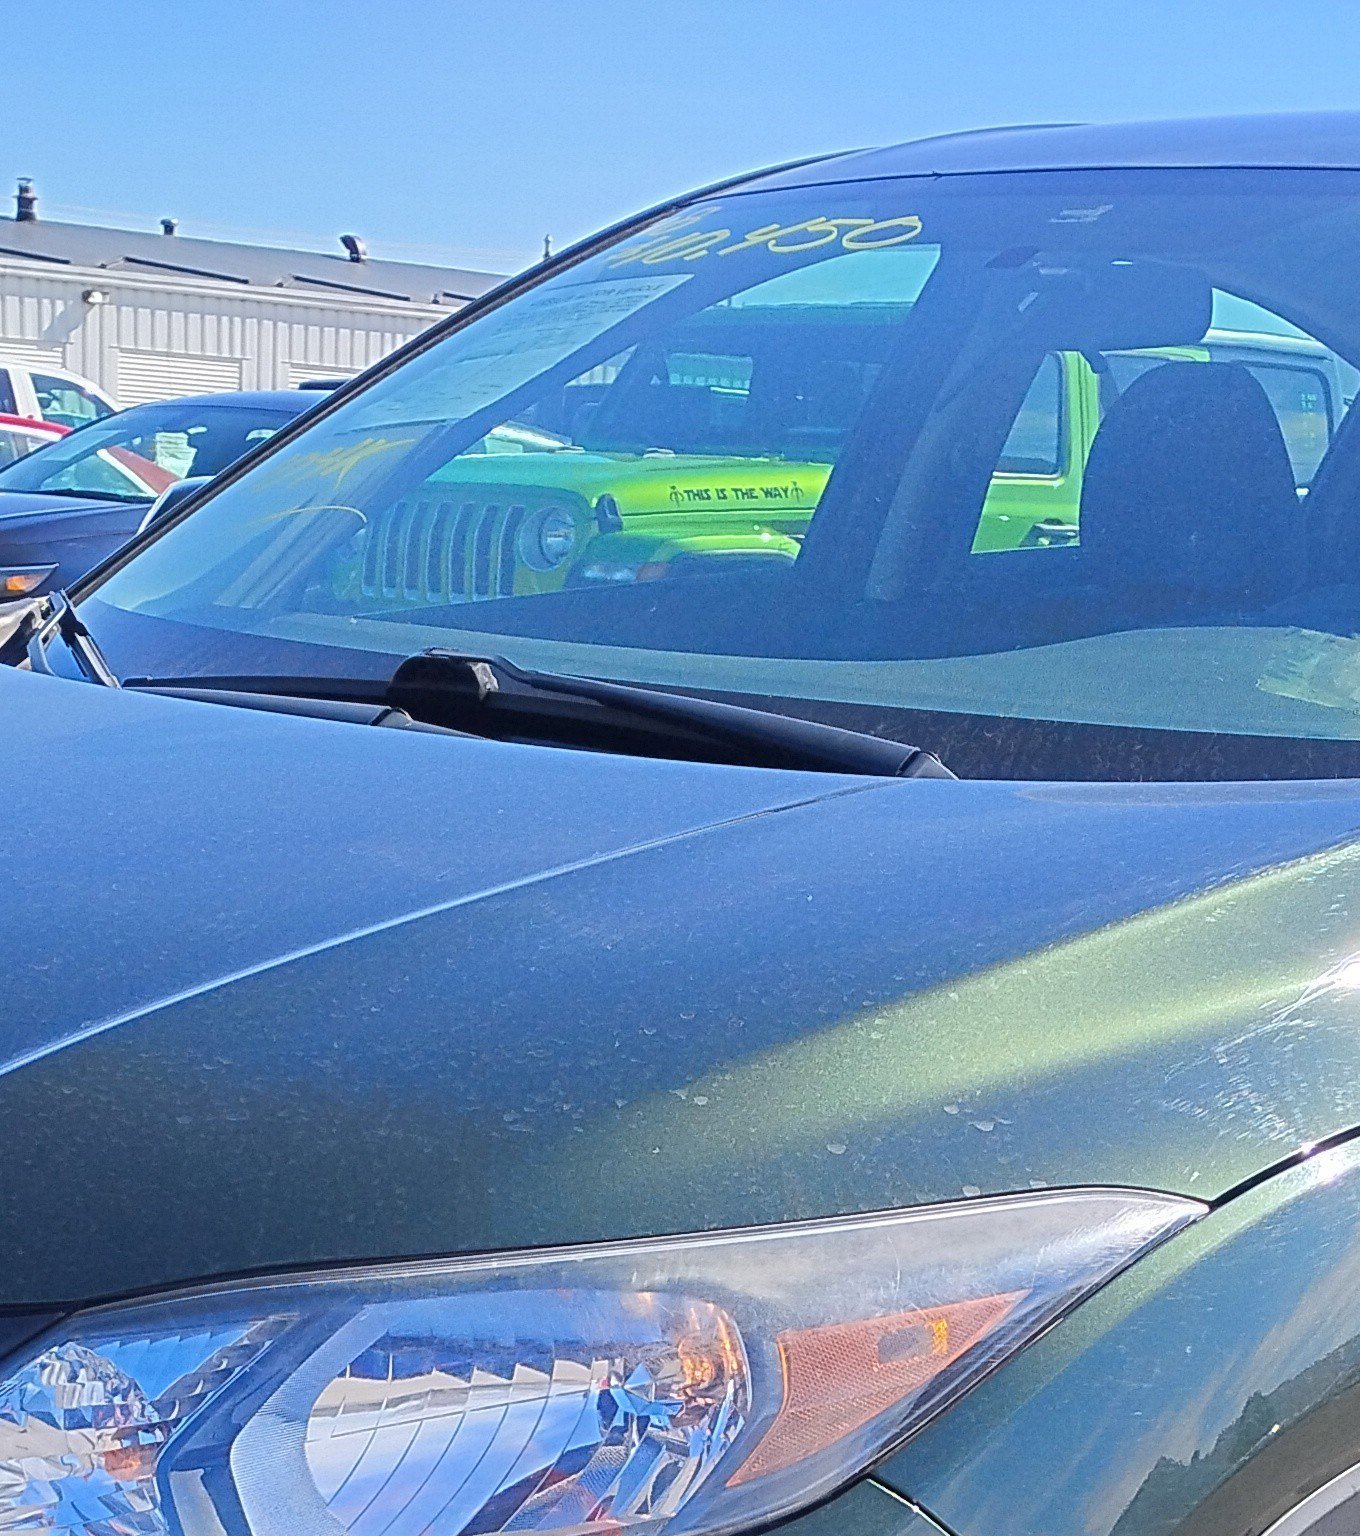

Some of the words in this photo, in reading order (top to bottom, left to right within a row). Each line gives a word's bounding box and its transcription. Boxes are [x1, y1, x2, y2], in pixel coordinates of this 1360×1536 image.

[683, 488, 712, 501] THIS
[715, 488, 728, 500] IS
[731, 487, 758, 500] THE
[759, 486, 789, 499] WAY
